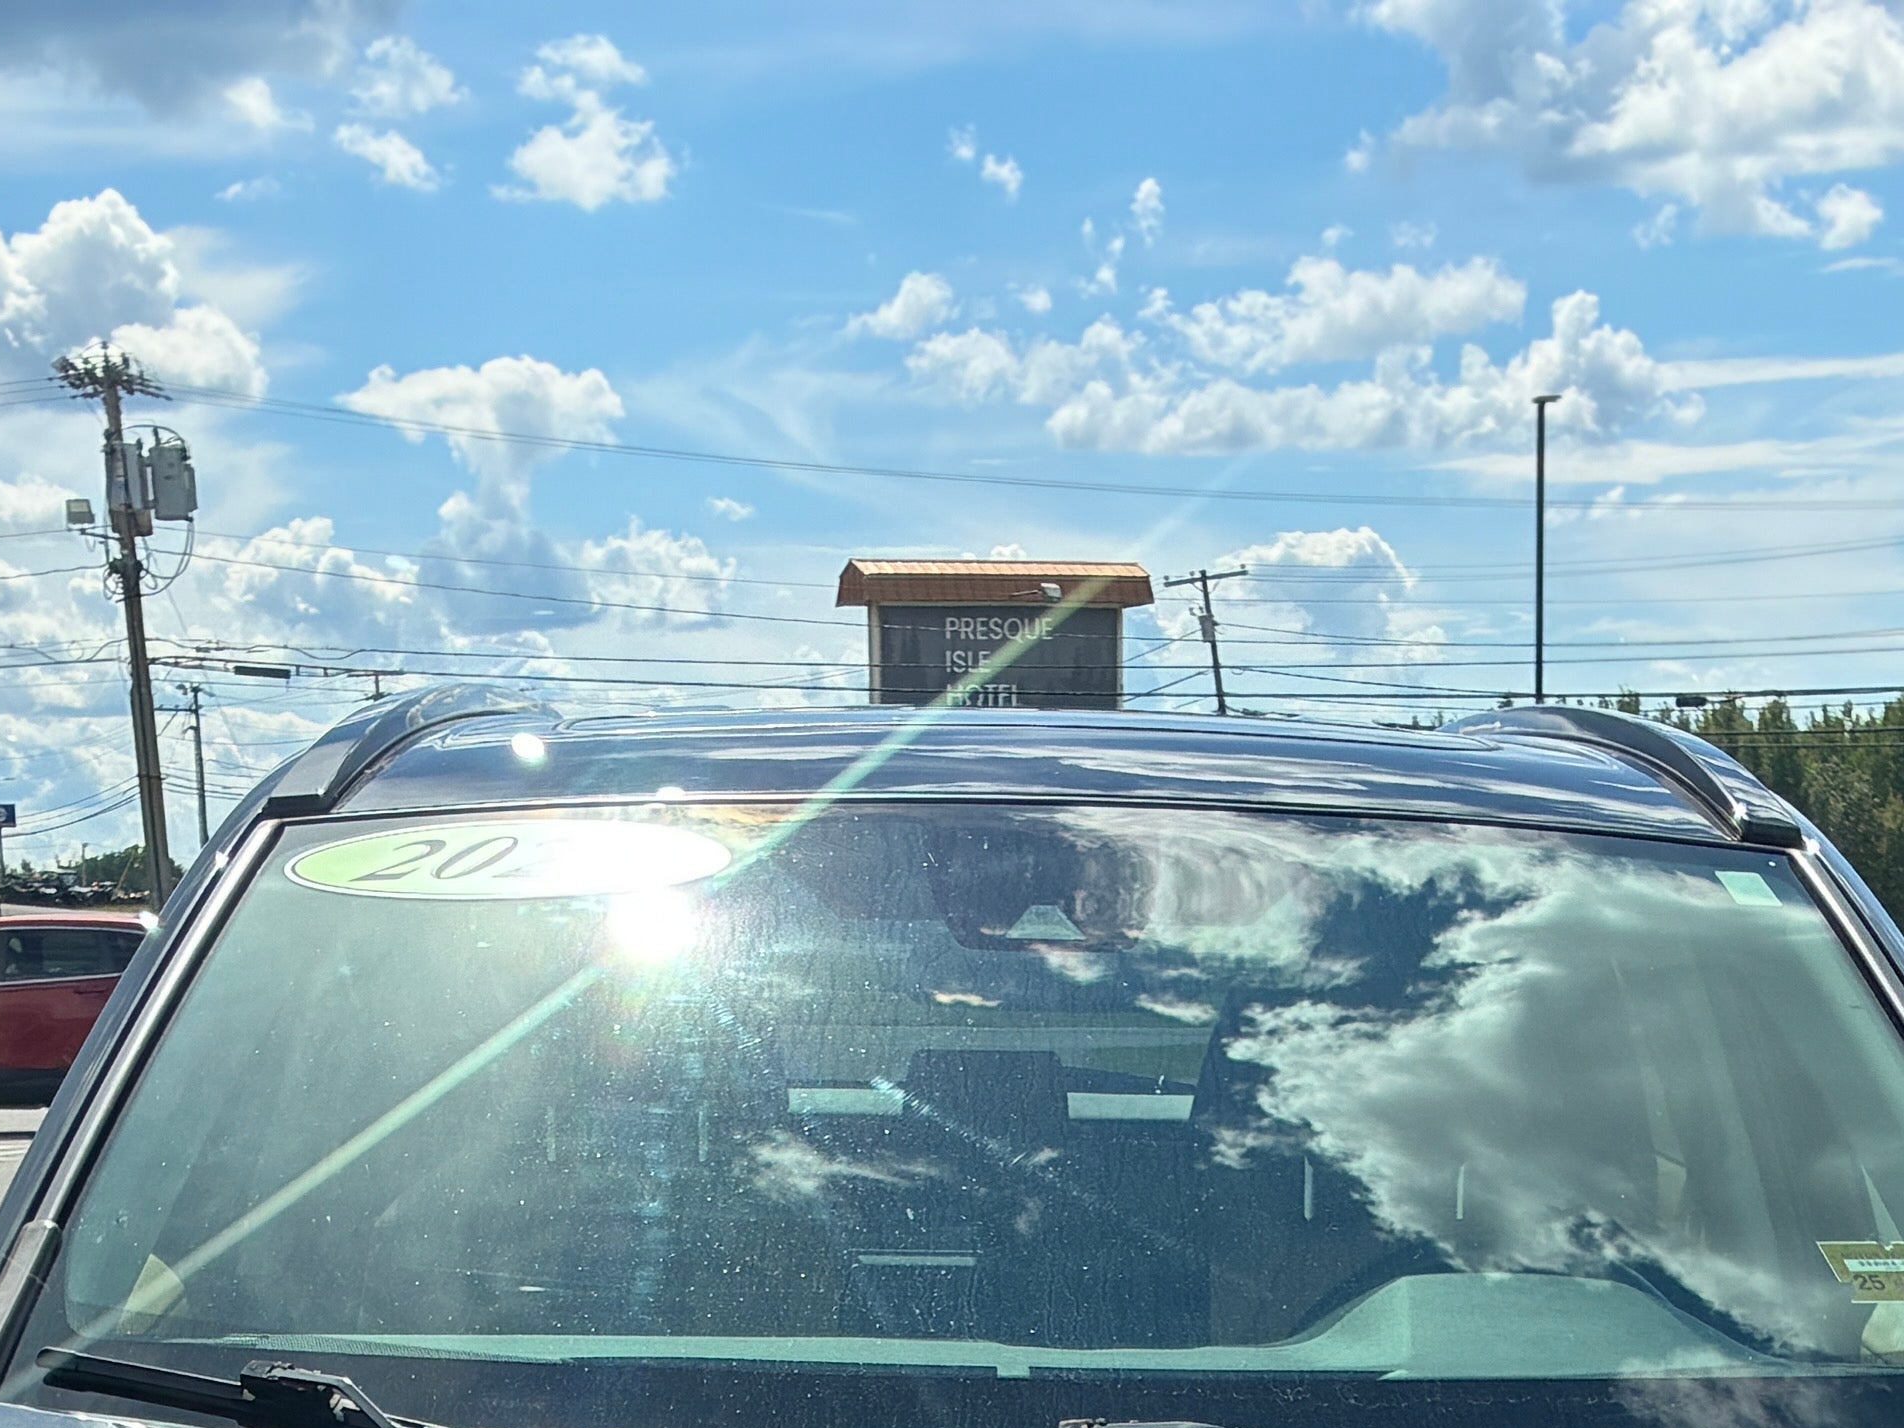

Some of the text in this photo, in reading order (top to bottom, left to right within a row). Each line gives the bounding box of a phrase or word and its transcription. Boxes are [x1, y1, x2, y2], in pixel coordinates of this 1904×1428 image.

[944, 616, 1054, 643] PRESQUE
[944, 649, 992, 673] ISLE
[1852, 1274, 1886, 1292] 25
